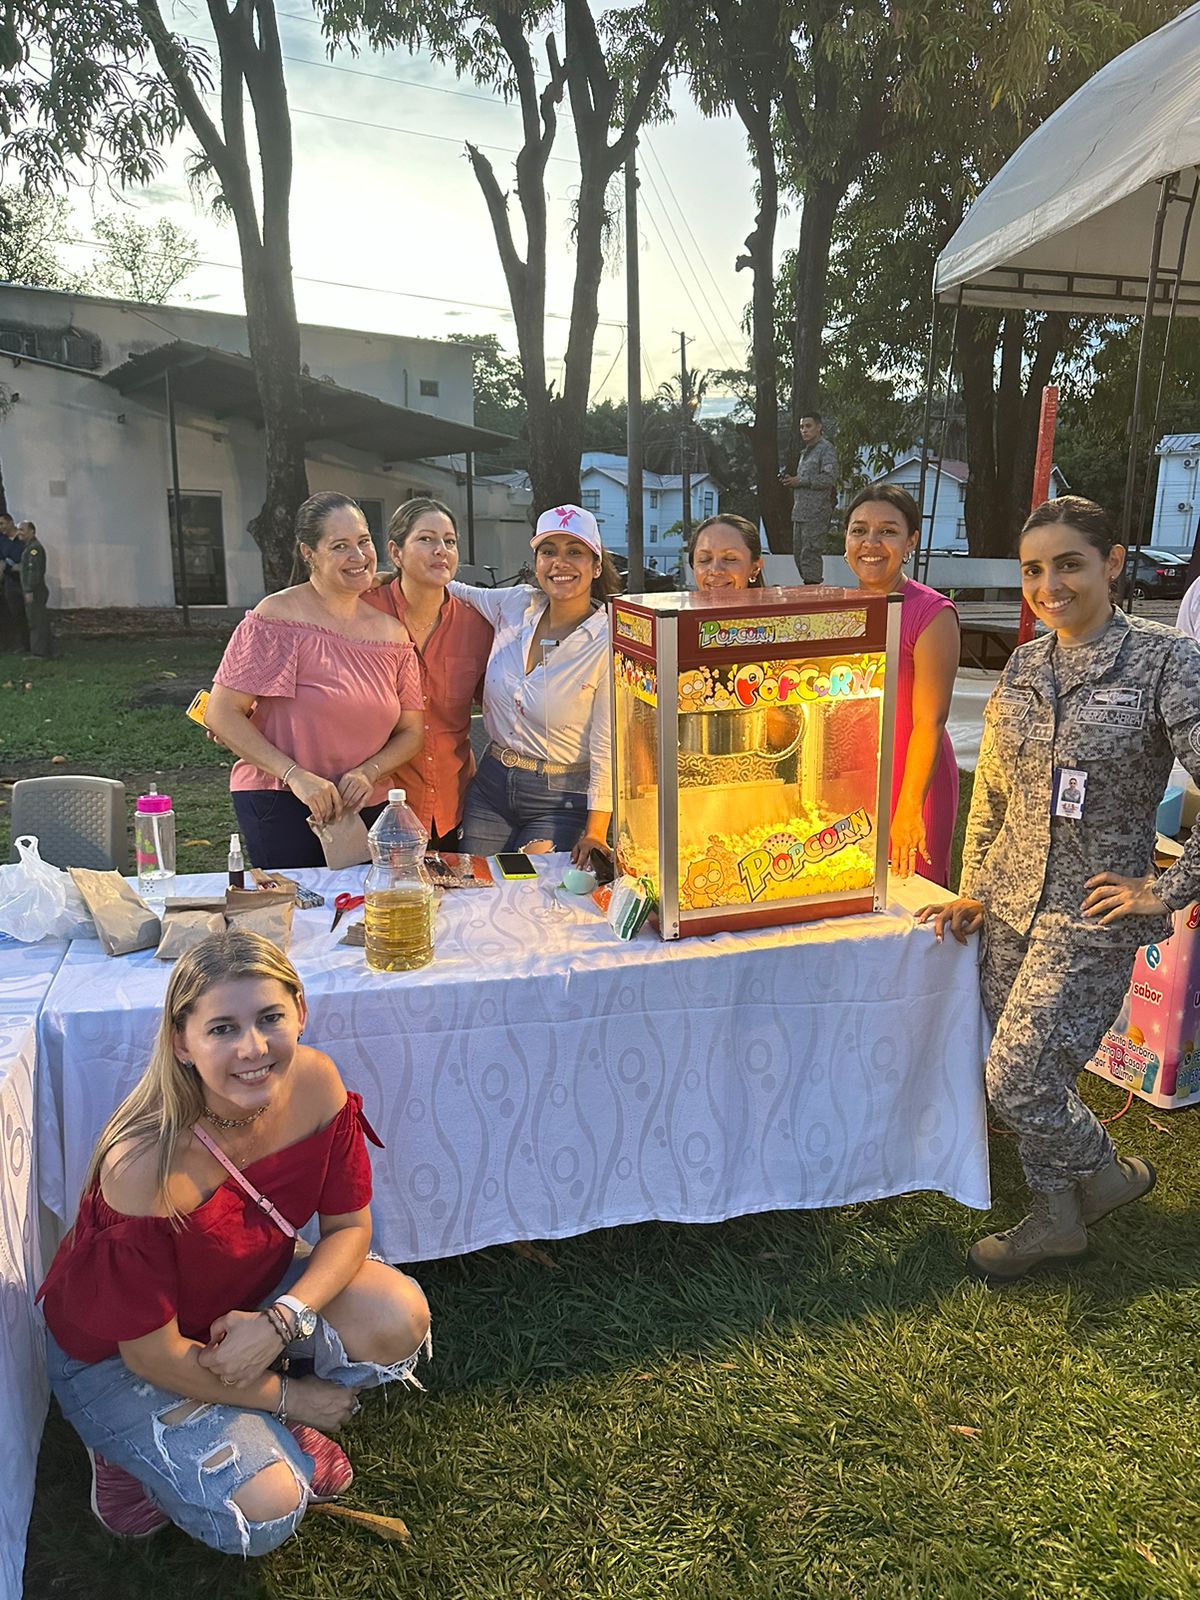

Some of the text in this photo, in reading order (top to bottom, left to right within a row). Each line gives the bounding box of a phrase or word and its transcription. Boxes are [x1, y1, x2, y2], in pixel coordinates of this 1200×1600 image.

[700, 620, 776, 648] POPCORN
[738, 807, 872, 902] POPCORN
[1133, 982, 1162, 1004] sabor
[1099, 1043, 1115, 1058] zana
[1123, 1053, 1140, 1070] Casa
[1141, 1062, 1147, 1073] 2
[1107, 1029, 1155, 1061] Santa Barbara
[1111, 1061, 1134, 1082] Tolima
